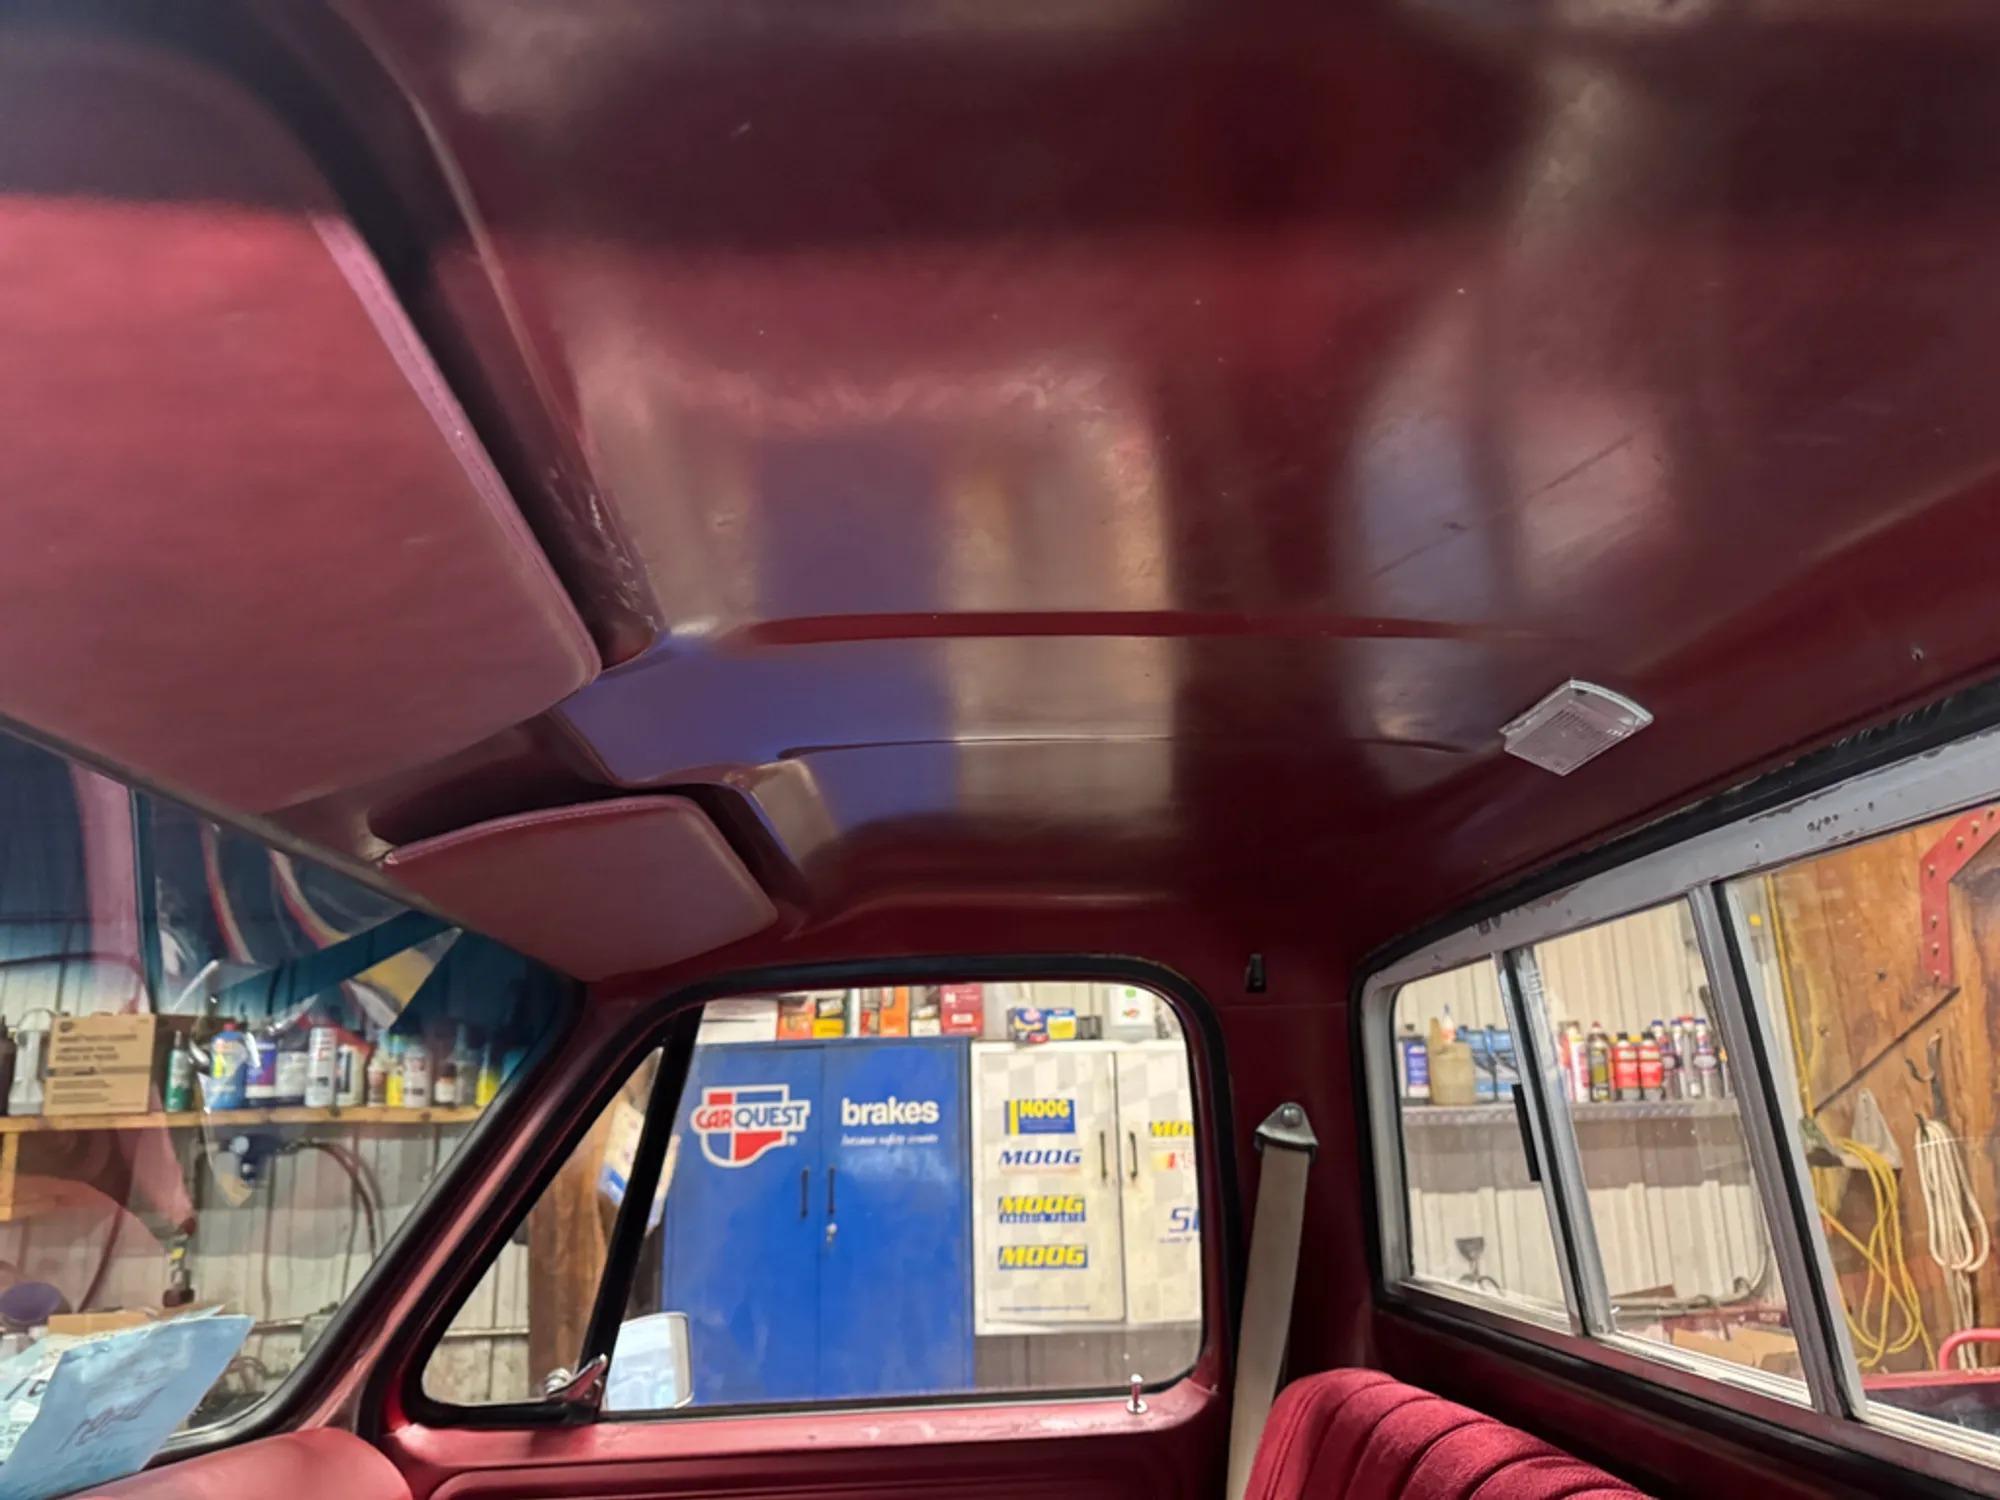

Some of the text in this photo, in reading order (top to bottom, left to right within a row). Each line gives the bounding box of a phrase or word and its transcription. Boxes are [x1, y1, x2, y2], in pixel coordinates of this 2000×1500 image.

[695, 1105, 805, 1130] CARQUEST
[841, 1096, 940, 1126] brakes
[1020, 1098, 1070, 1118] MOOG
[1001, 1148, 1082, 1165] MOOG
[1001, 1195, 1084, 1214] MOOG
[1001, 1245, 1086, 1267] MOOG
